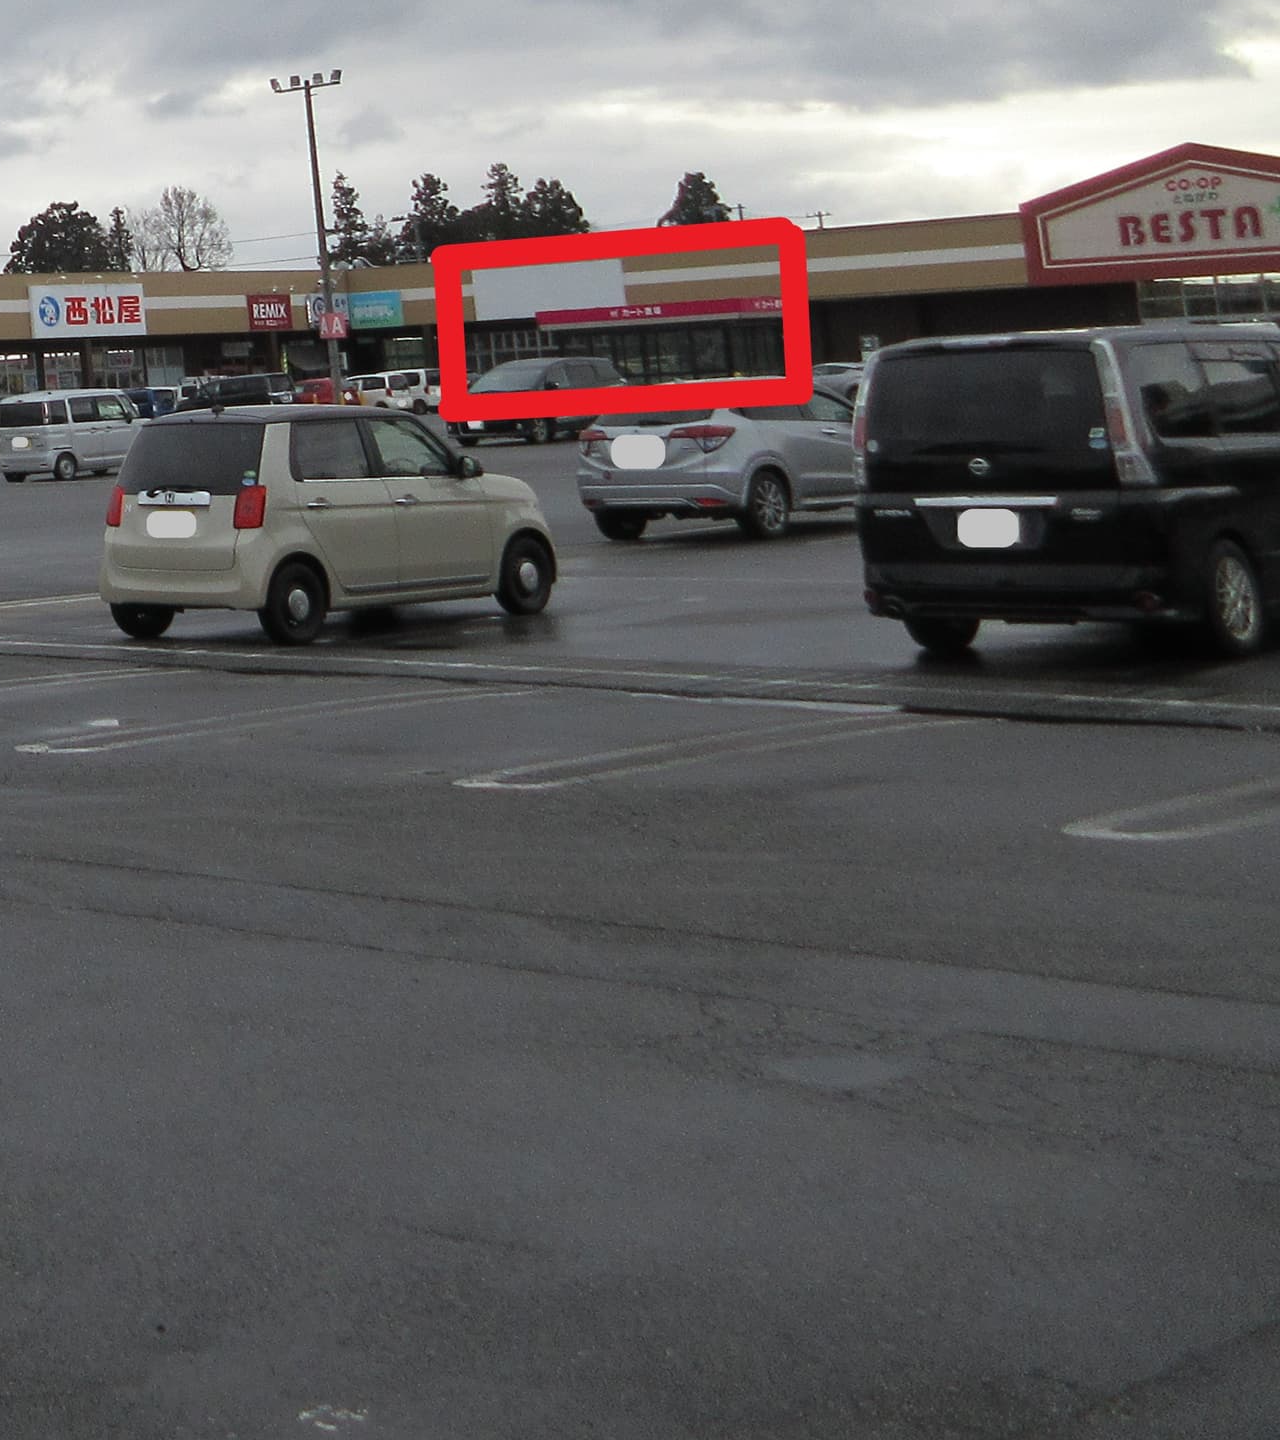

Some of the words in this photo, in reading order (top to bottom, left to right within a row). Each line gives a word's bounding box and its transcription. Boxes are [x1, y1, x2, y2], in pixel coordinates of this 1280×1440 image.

[1118, 206, 1263, 247] BESTA
[64, 295, 142, 326] 西松屋
[252, 303, 288, 319] REMIX
[332, 315, 344, 335] A
